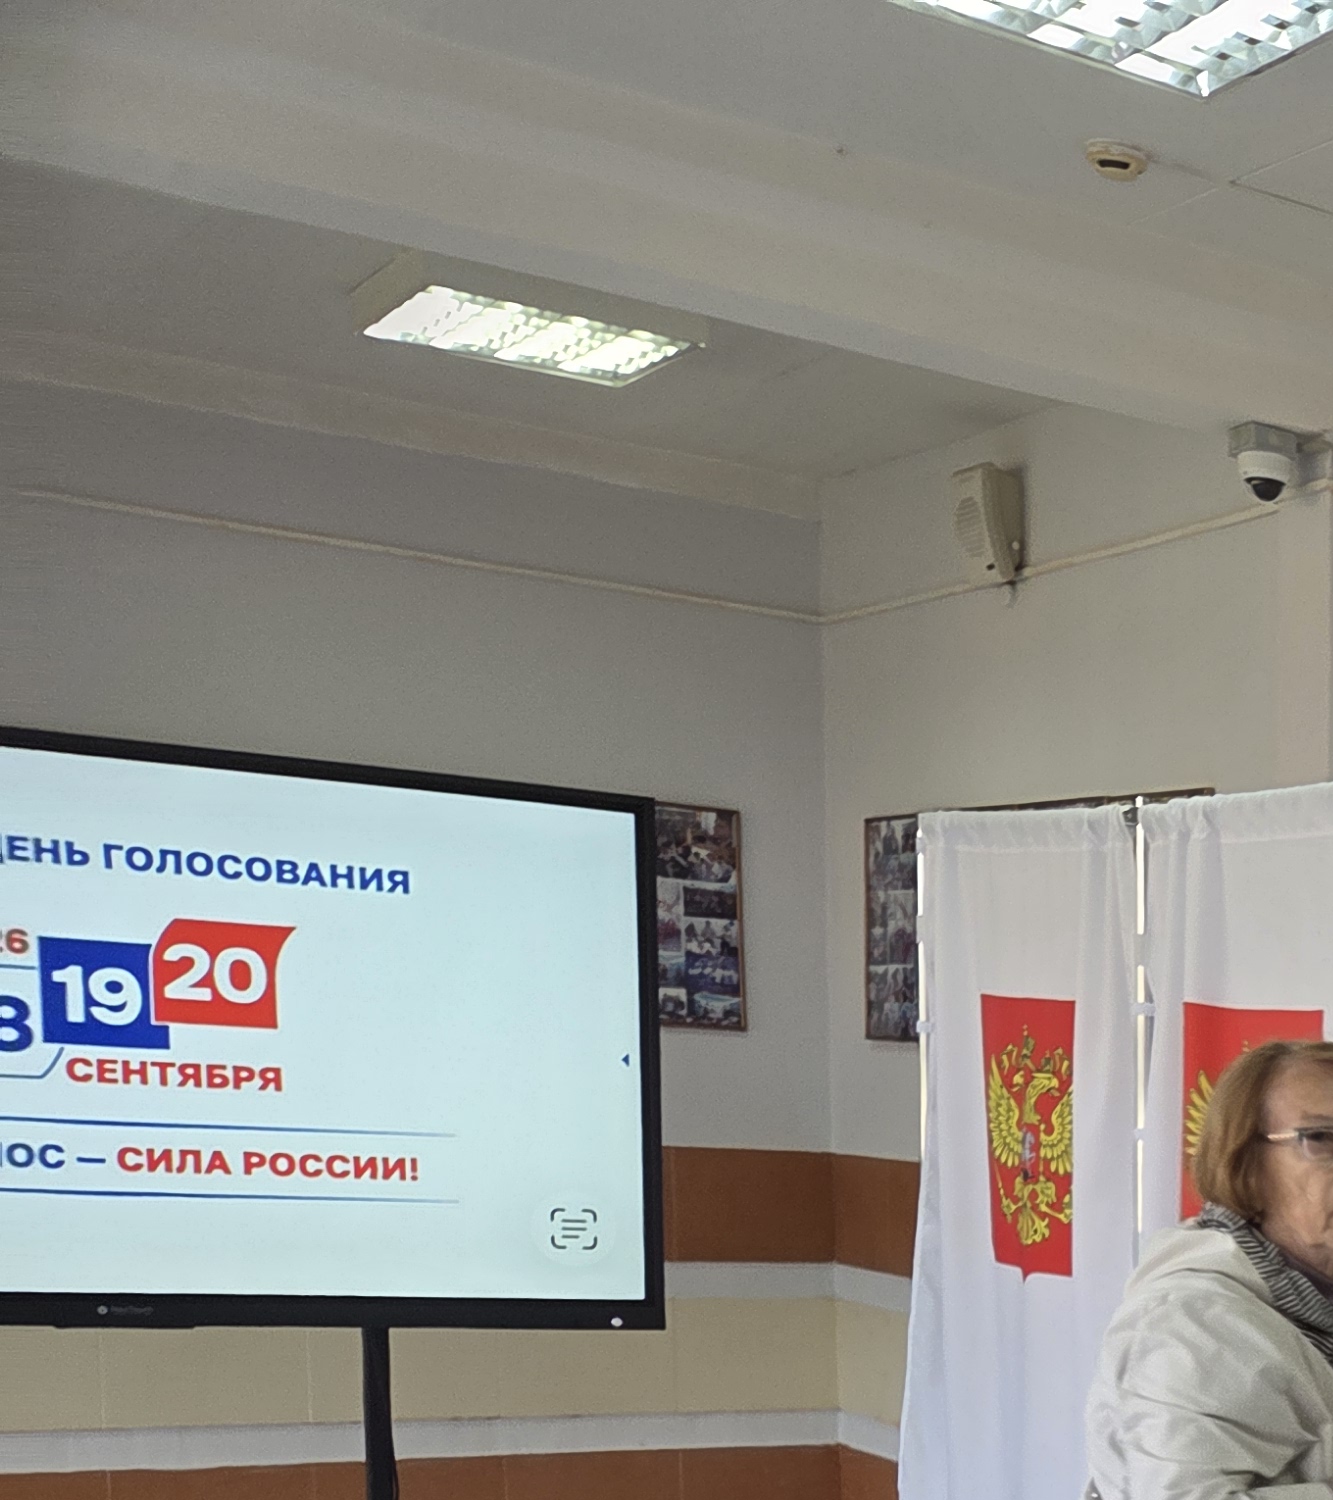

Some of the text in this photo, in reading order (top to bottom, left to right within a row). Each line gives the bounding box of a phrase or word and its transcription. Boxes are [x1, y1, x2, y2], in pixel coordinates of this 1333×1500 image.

[0, 834, 411, 895] ЕНЬ ГОЛОСОВАНИЯ
[0, 928, 30, 955] 6
[51, 964, 143, 1026] 19
[162, 943, 268, 1004] 20
[65, 1057, 284, 1092] СЕНТЯБРЯ
[0, 1142, 66, 1169] ОС
[116, 1146, 232, 1175] СИЛА
[242, 1151, 419, 1182] РОССИИ!
